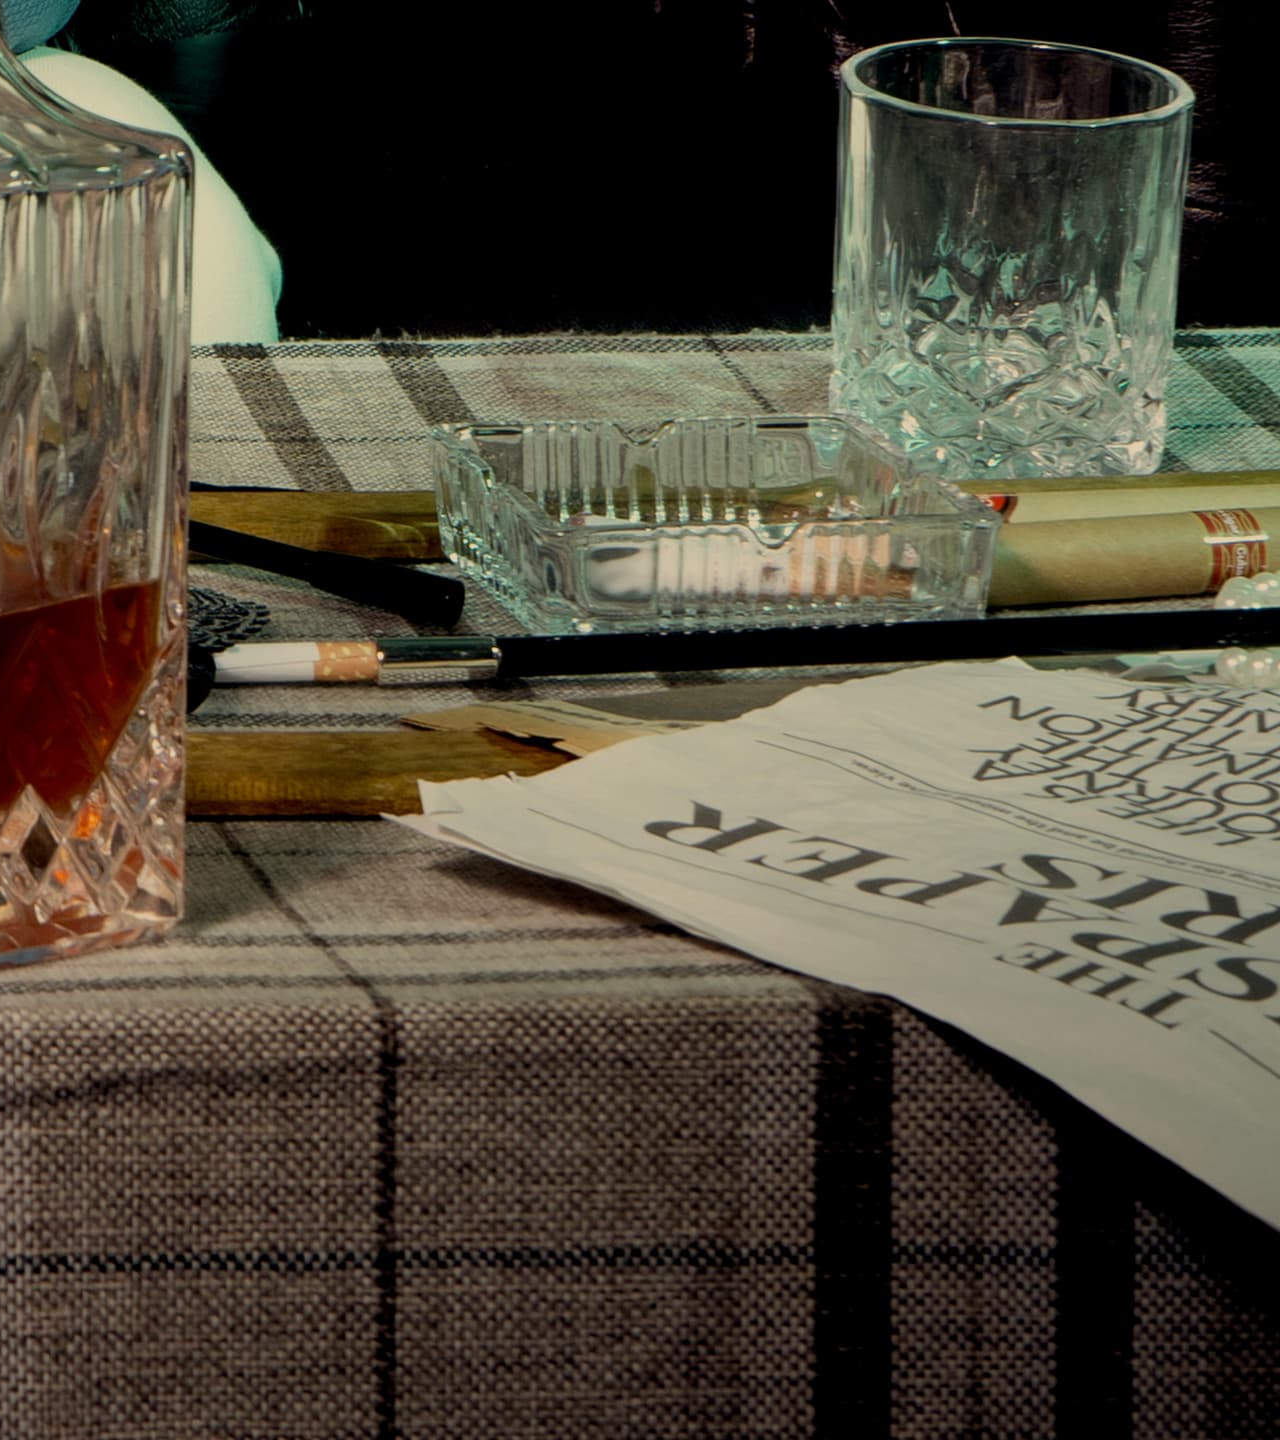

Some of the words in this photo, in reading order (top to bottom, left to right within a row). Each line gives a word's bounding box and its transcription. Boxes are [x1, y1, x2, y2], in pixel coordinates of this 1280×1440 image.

[1093, 689, 1280, 735] NERY
[1099, 708, 1243, 752] THE
[977, 695, 1280, 784] INATION
[1018, 733, 1159, 784] THE
[967, 747, 1280, 836] OURNEY
[972, 760, 1040, 782] A
[1023, 784, 1104, 804] IS
[1096, 802, 1255, 846] LIFE
[643, 800, 1280, 1020] SPAPER
[993, 942, 1197, 1031] THE
